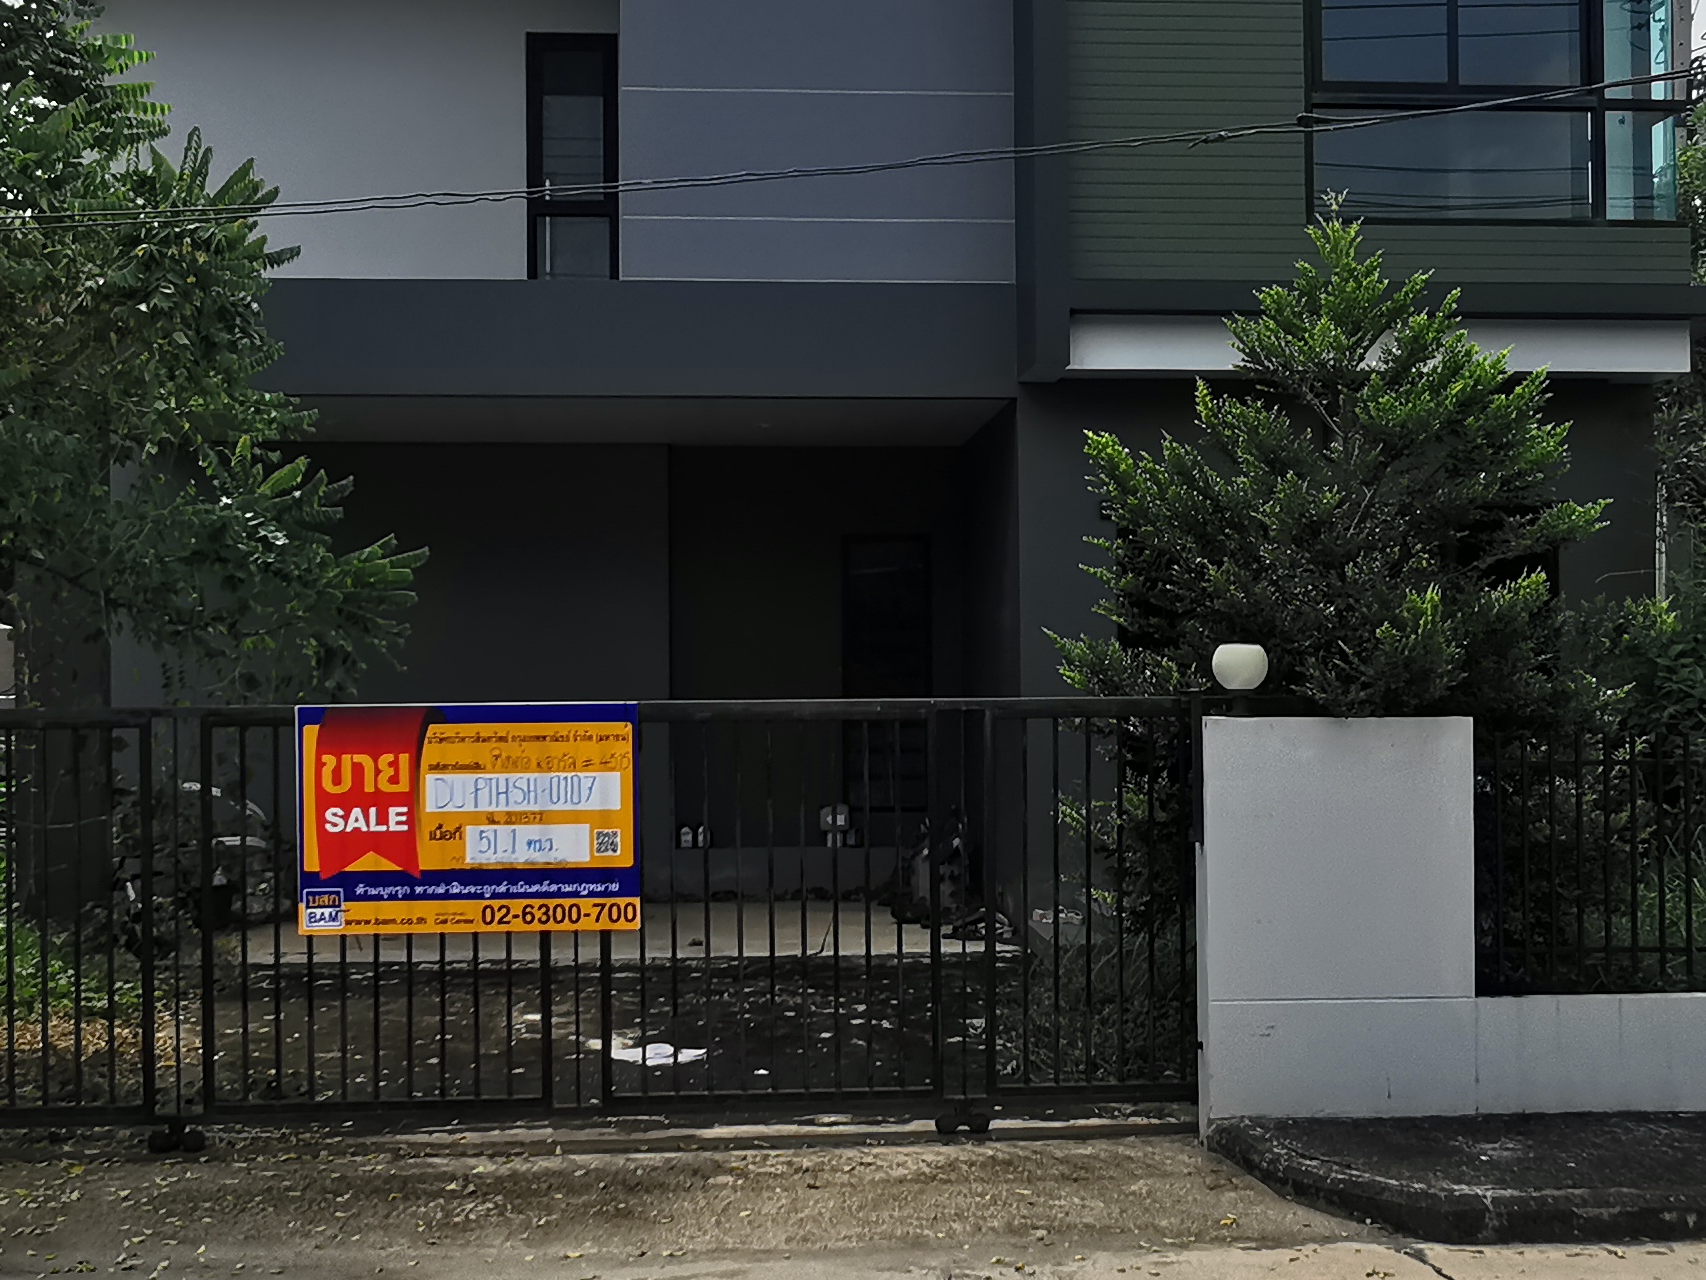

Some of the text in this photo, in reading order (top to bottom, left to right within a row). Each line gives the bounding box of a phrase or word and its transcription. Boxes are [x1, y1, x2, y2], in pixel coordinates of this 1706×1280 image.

[322, 753, 409, 794] ขาย
[325, 807, 409, 833] SALE
[478, 827, 516, 855] 51.1
[308, 911, 339, 924] BAM
[481, 902, 637, 926] 02-6300-700
